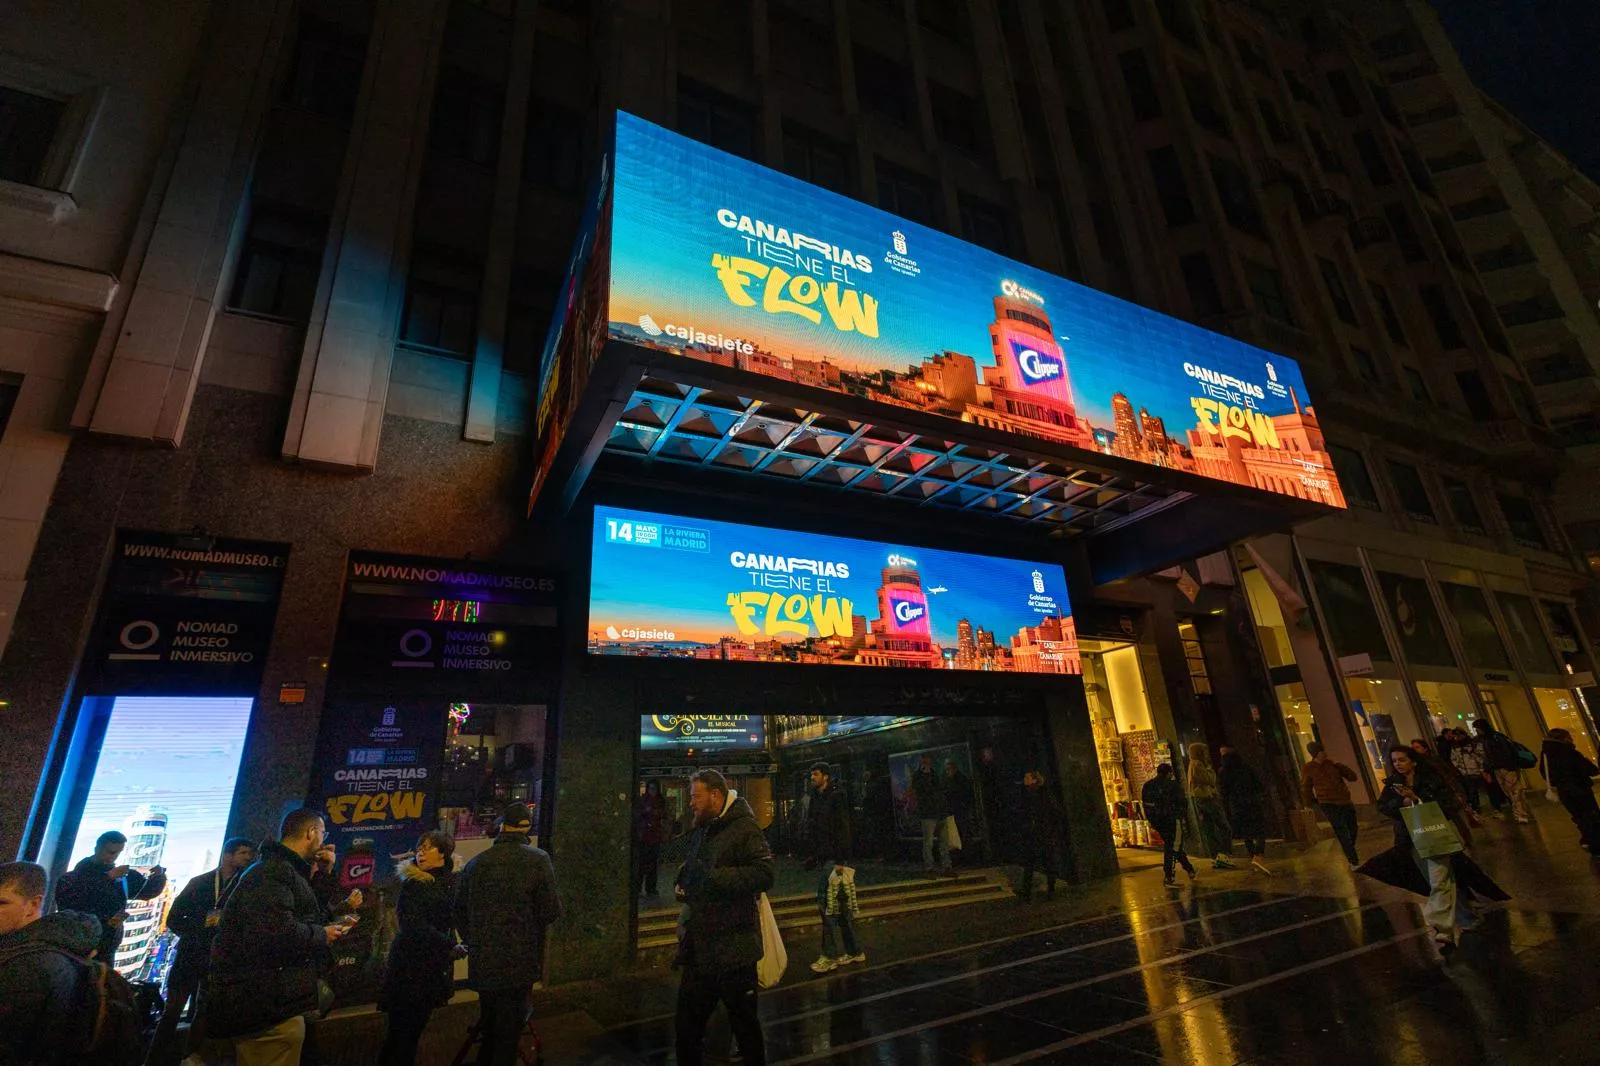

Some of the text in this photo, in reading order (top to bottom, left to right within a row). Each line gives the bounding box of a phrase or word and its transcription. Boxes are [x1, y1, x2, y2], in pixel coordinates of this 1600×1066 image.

[717, 208, 873, 274] CANARIAS
[740, 235, 856, 286] TIENE EL
[887, 251, 917, 266] Gobierno
[893, 259, 921, 273] Canarias
[711, 252, 880, 339] FLOW
[664, 323, 754, 355] cajasiete
[1019, 349, 1059, 379] Clipper
[1183, 362, 1265, 400] CANARIAS
[1198, 381, 1244, 405] TIENE
[1245, 397, 1260, 410] EL
[1190, 397, 1280, 449] FLOW
[608, 520, 657, 542] 14 MAYO
[664, 528, 706, 539] LA RIVIERA
[664, 536, 706, 549] MADRID
[730, 551, 850, 579] CANARIAS
[353, 562, 556, 592] WWW.NOMADMUSEO.ES
[748, 571, 836, 593] TIENE EL
[1029, 594, 1053, 602] Gobierno
[1034, 600, 1057, 608] Canarias
[726, 591, 854, 638] FLOW
[176, 620, 239, 634] NOMAD
[621, 627, 675, 640] cajasiete
[172, 635, 229, 648] MUSEO
[169, 650, 254, 663] INMERSIVO
[444, 644, 490, 656] MUSEO
[442, 658, 512, 670] INMERSIVO
[348, 750, 366, 763] 14
[334, 767, 428, 781] CANARIAS
[347, 780, 413, 792] TIENE EL
[326, 790, 426, 824] FLOW
